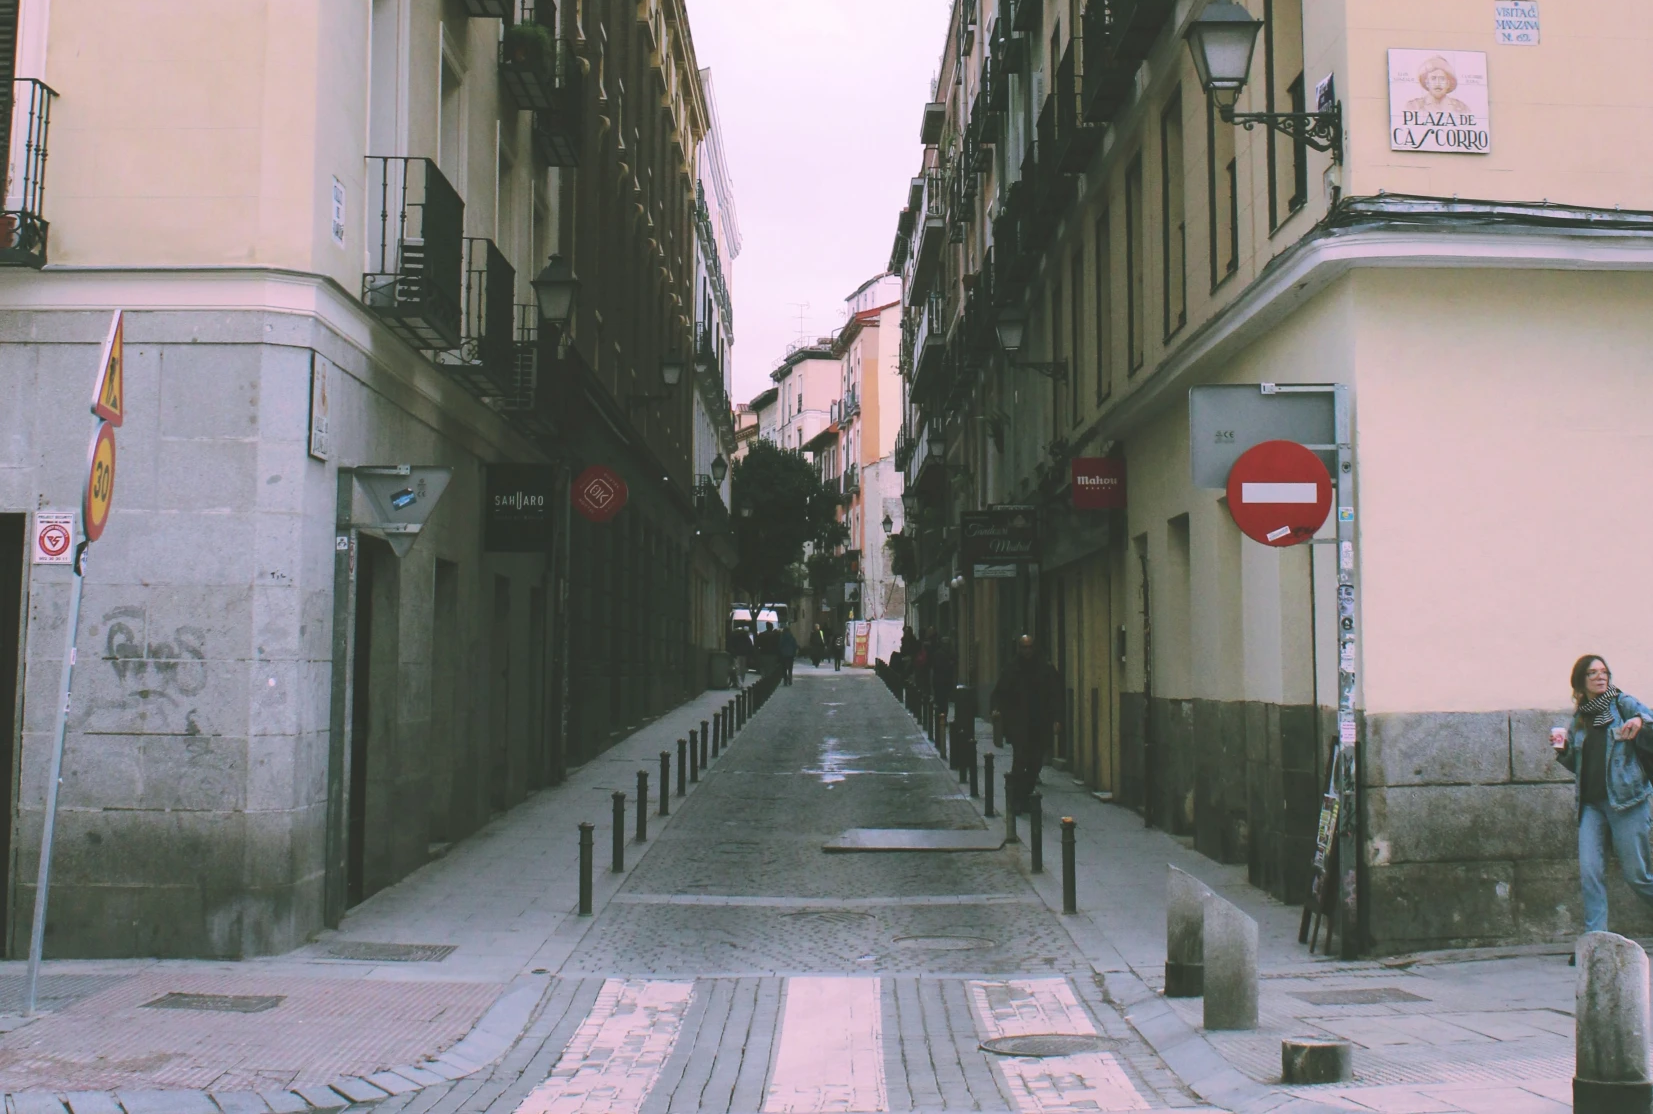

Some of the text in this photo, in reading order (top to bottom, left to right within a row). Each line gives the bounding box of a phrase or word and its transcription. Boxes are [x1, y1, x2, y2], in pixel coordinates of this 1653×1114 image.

[1496, 7, 1527, 18] VISITA
[1496, 20, 1540, 31] MANZANA
[1402, 110, 1477, 127] PLAZA DE
[1393, 128, 1488, 150] CASCORRO
[94, 461, 110, 502] 30
[1077, 475, 1118, 485] Mahou
[494, 491, 544, 510] SAHUARO
[589, 484, 609, 504] OK
[989, 538, 1032, 553] Madrid
